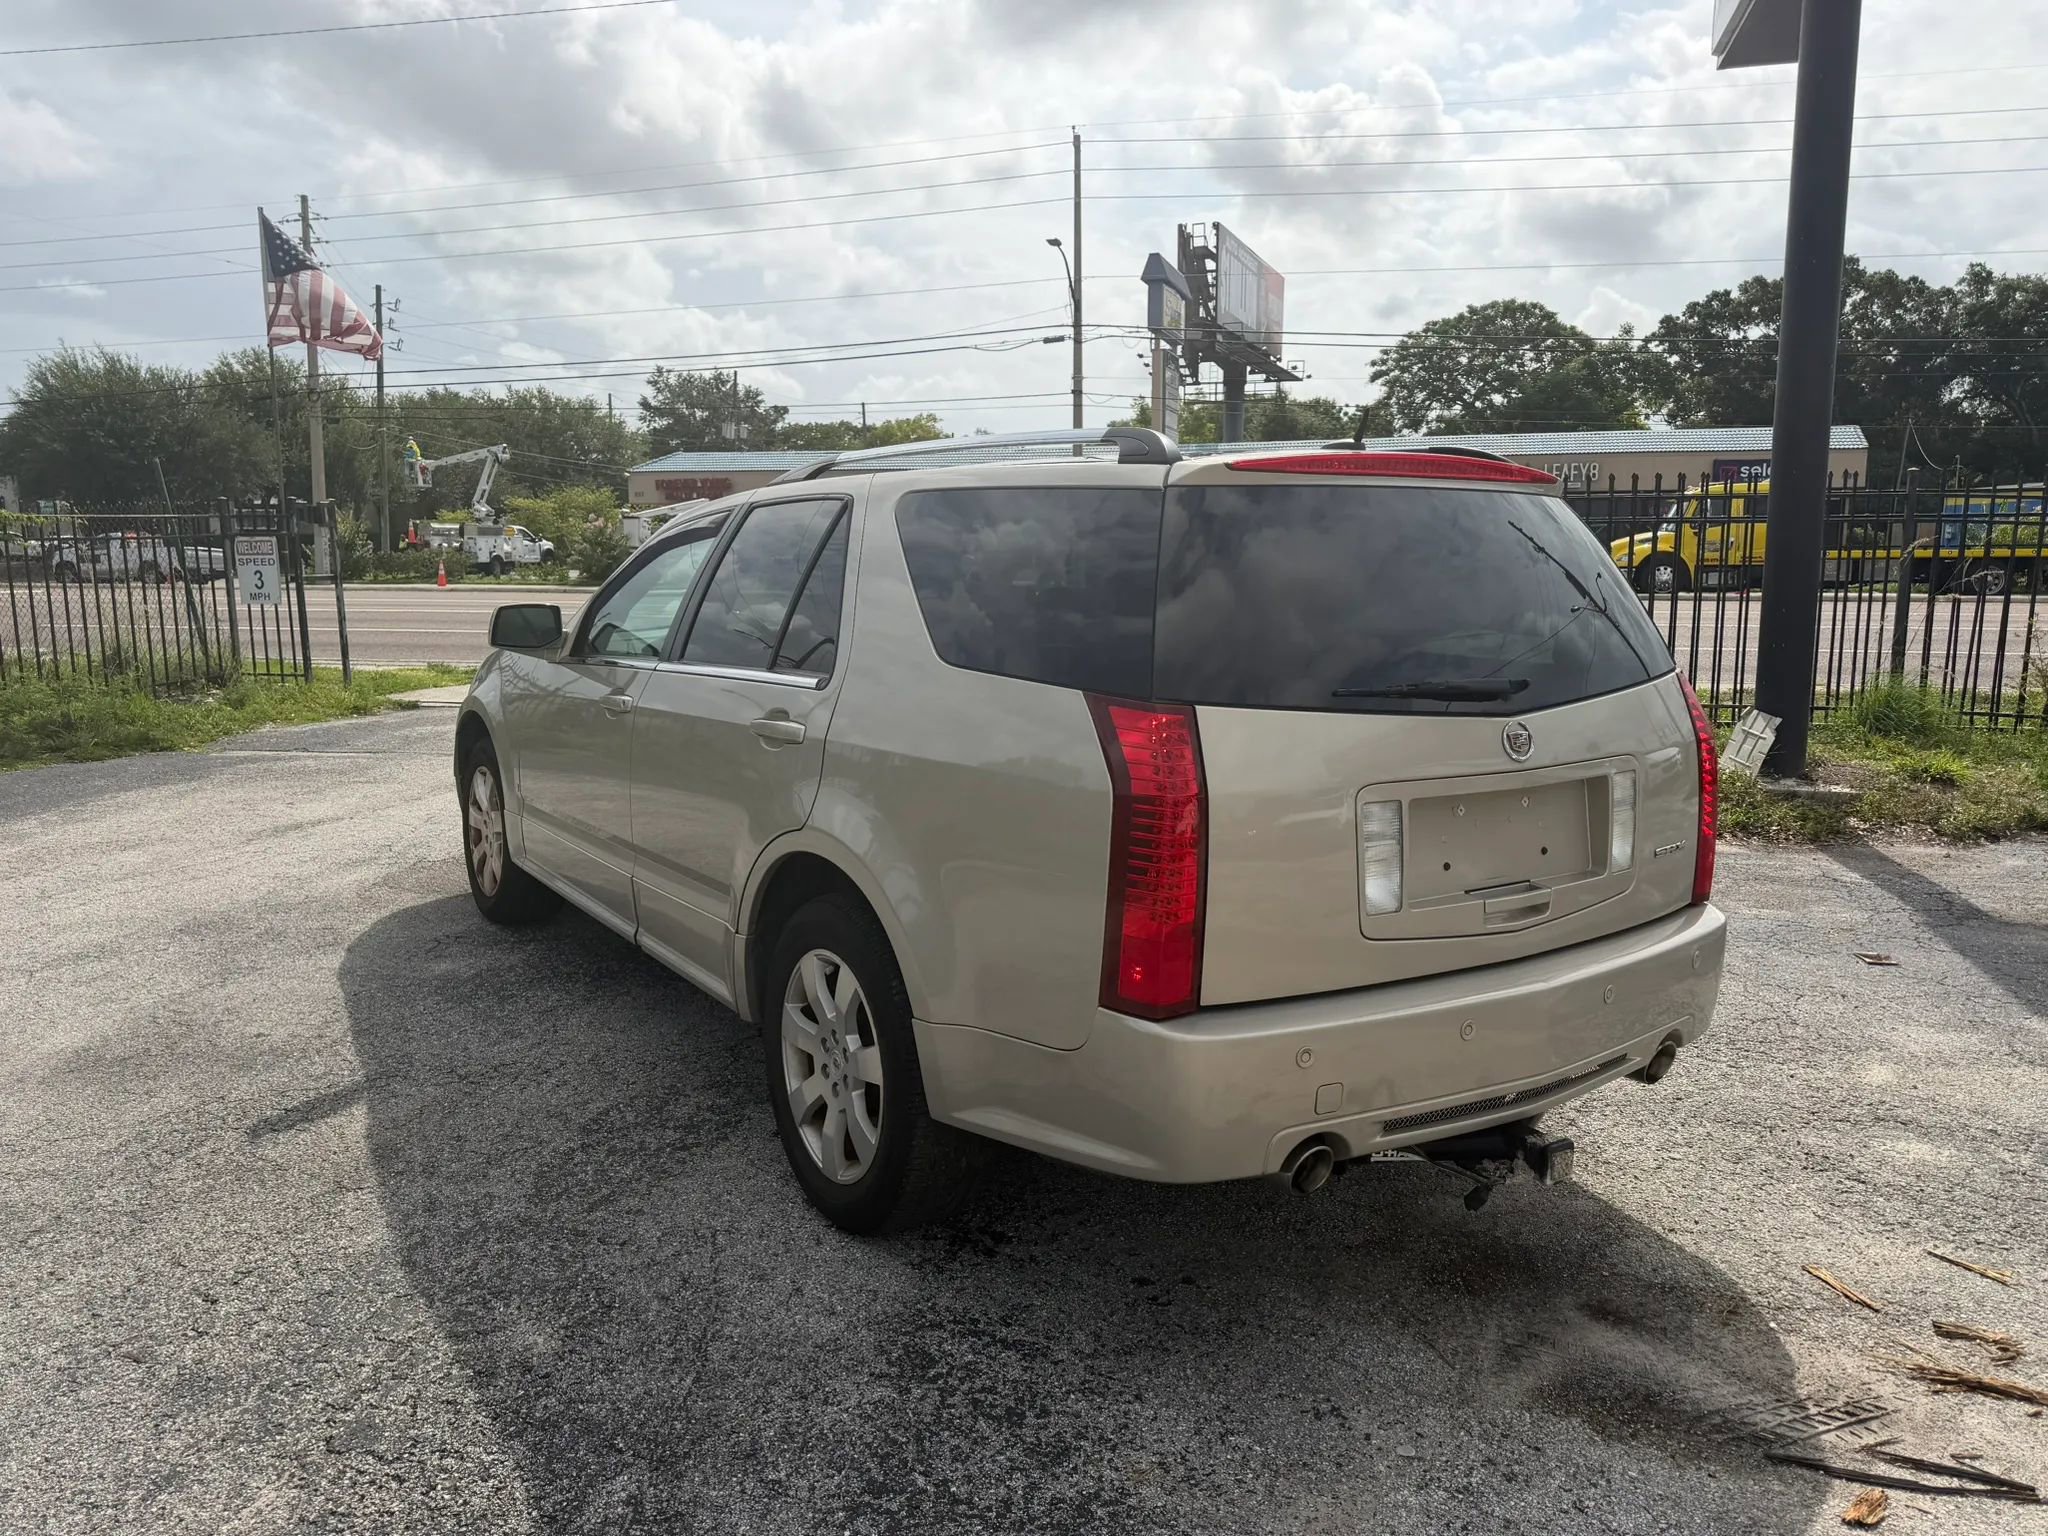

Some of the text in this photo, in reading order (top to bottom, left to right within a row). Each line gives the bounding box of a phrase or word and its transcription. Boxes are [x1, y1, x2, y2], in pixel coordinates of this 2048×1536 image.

[238, 541, 273, 554] WELCOME
[238, 557, 276, 567] SPEED
[254, 569, 264, 590] 3
[249, 592, 271, 601] MPH
